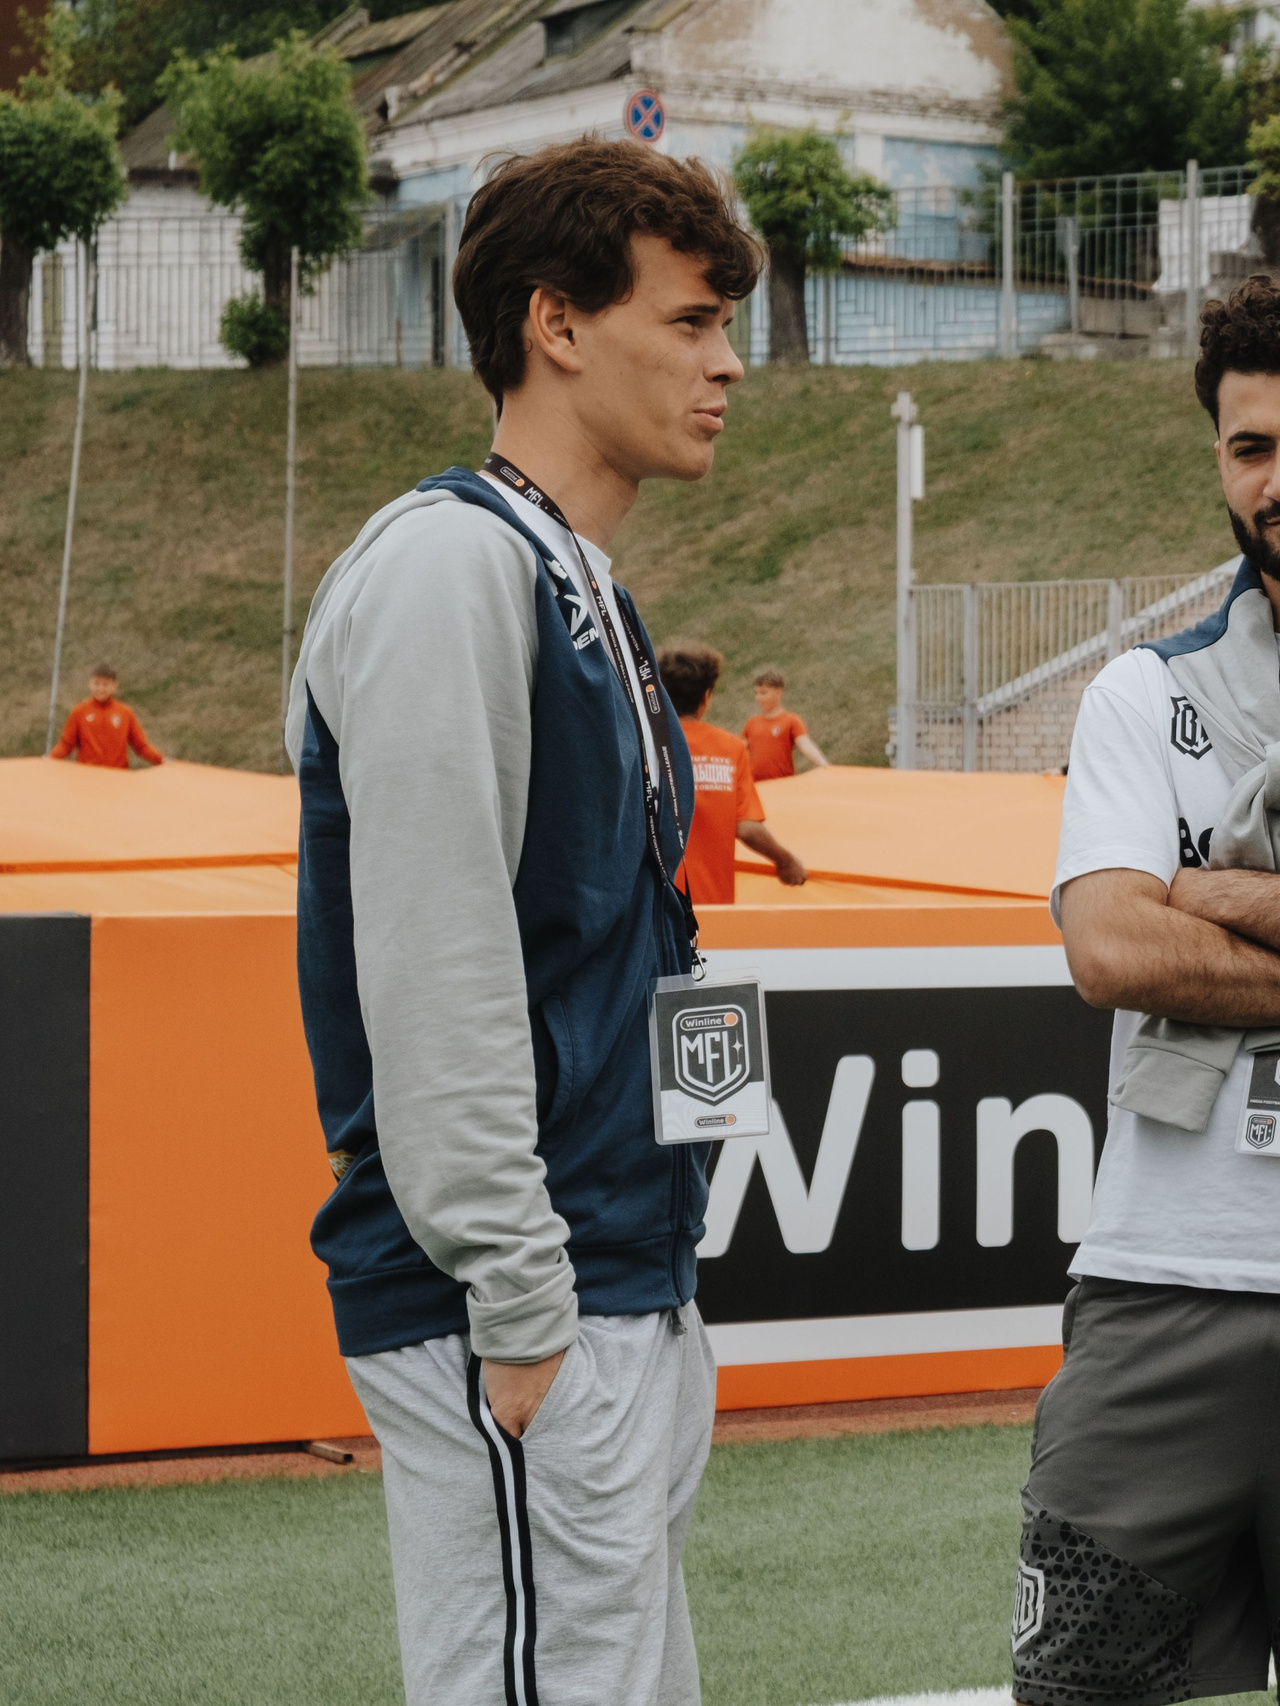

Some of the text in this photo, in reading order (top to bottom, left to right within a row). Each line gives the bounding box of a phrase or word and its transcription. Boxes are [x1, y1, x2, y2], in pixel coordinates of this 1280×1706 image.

[524, 486, 544, 508] MFL
[596, 596, 607, 616] MFL
[615, 648, 627, 679] FOOTBALL
[624, 680, 635, 703] LEAGUE
[639, 660, 652, 681] MFL
[662, 746, 670, 767] LEAGUE
[685, 1016, 722, 1028] Winline
[681, 1031, 742, 1093] MFL
[699, 1117, 724, 1126] Winline
[1251, 1124, 1271, 1143] MFL
